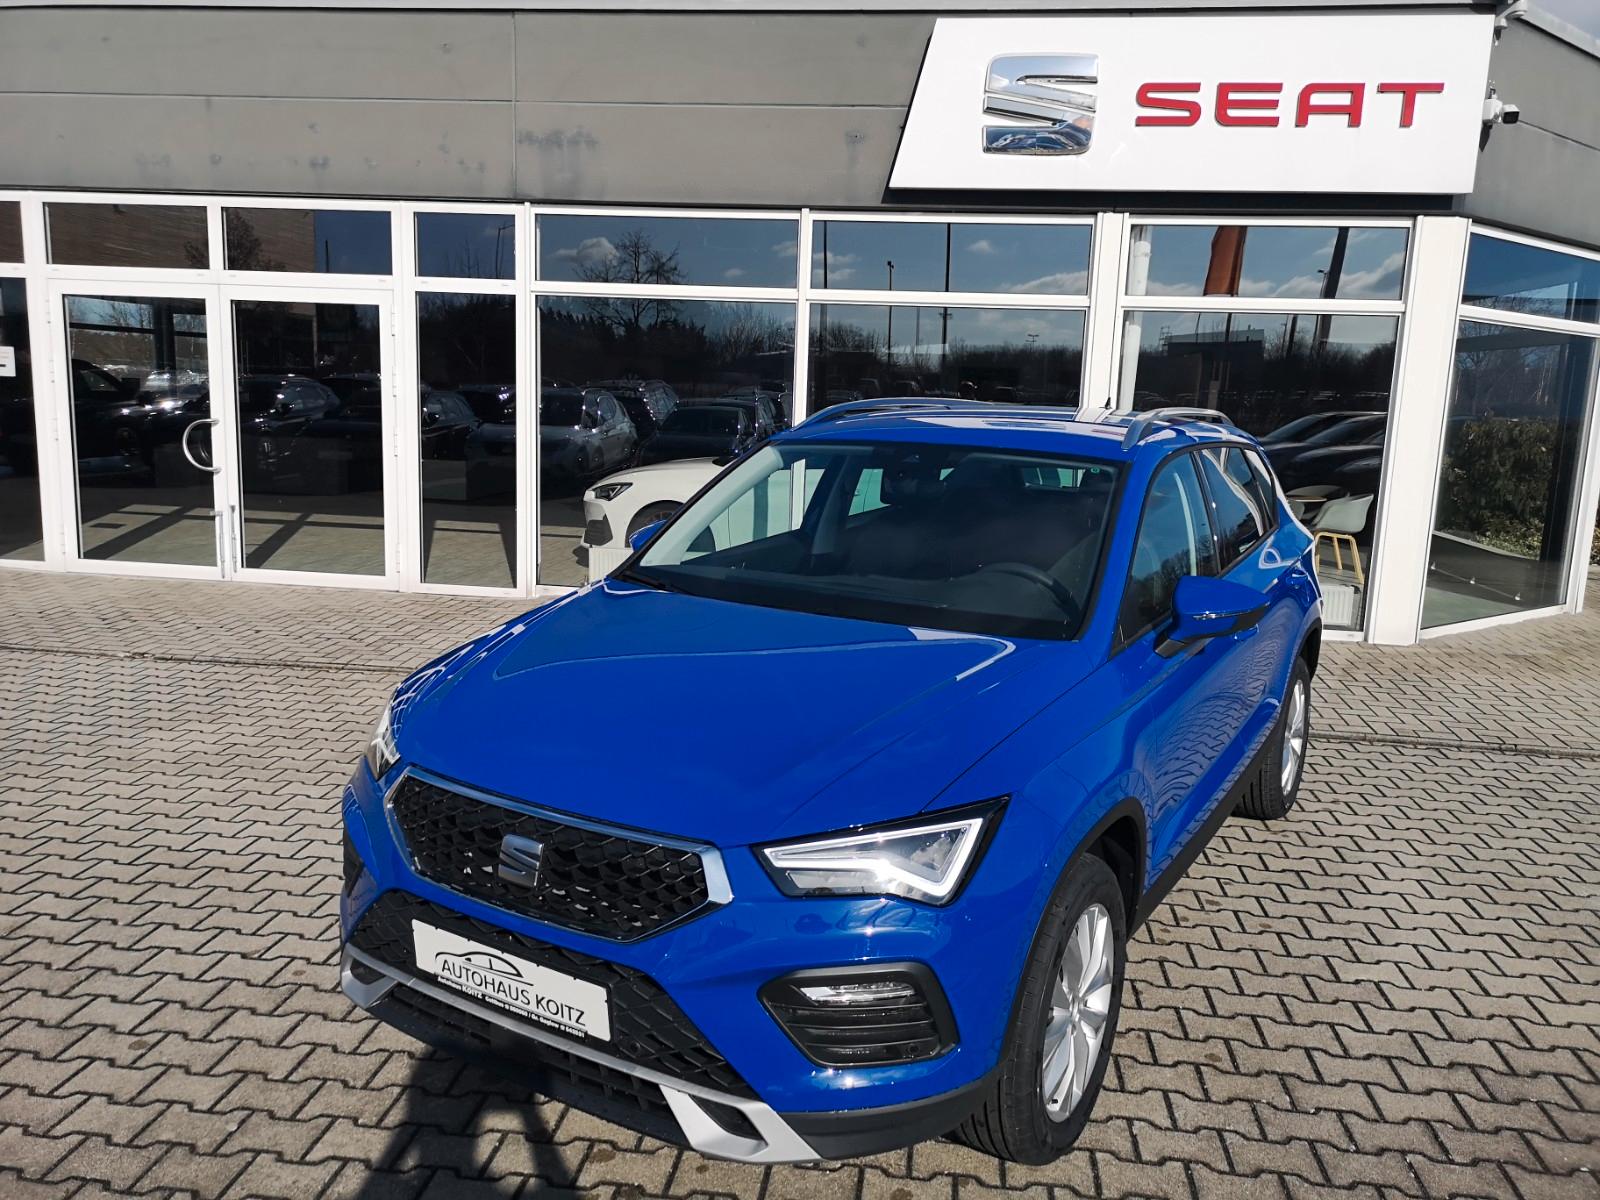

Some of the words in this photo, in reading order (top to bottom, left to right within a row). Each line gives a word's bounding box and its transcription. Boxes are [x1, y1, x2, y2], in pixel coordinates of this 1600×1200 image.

[1135, 82, 1445, 128] SEAT
[441, 958, 531, 1006] AUTOHAUS
[535, 993, 586, 1027] KOITZ
